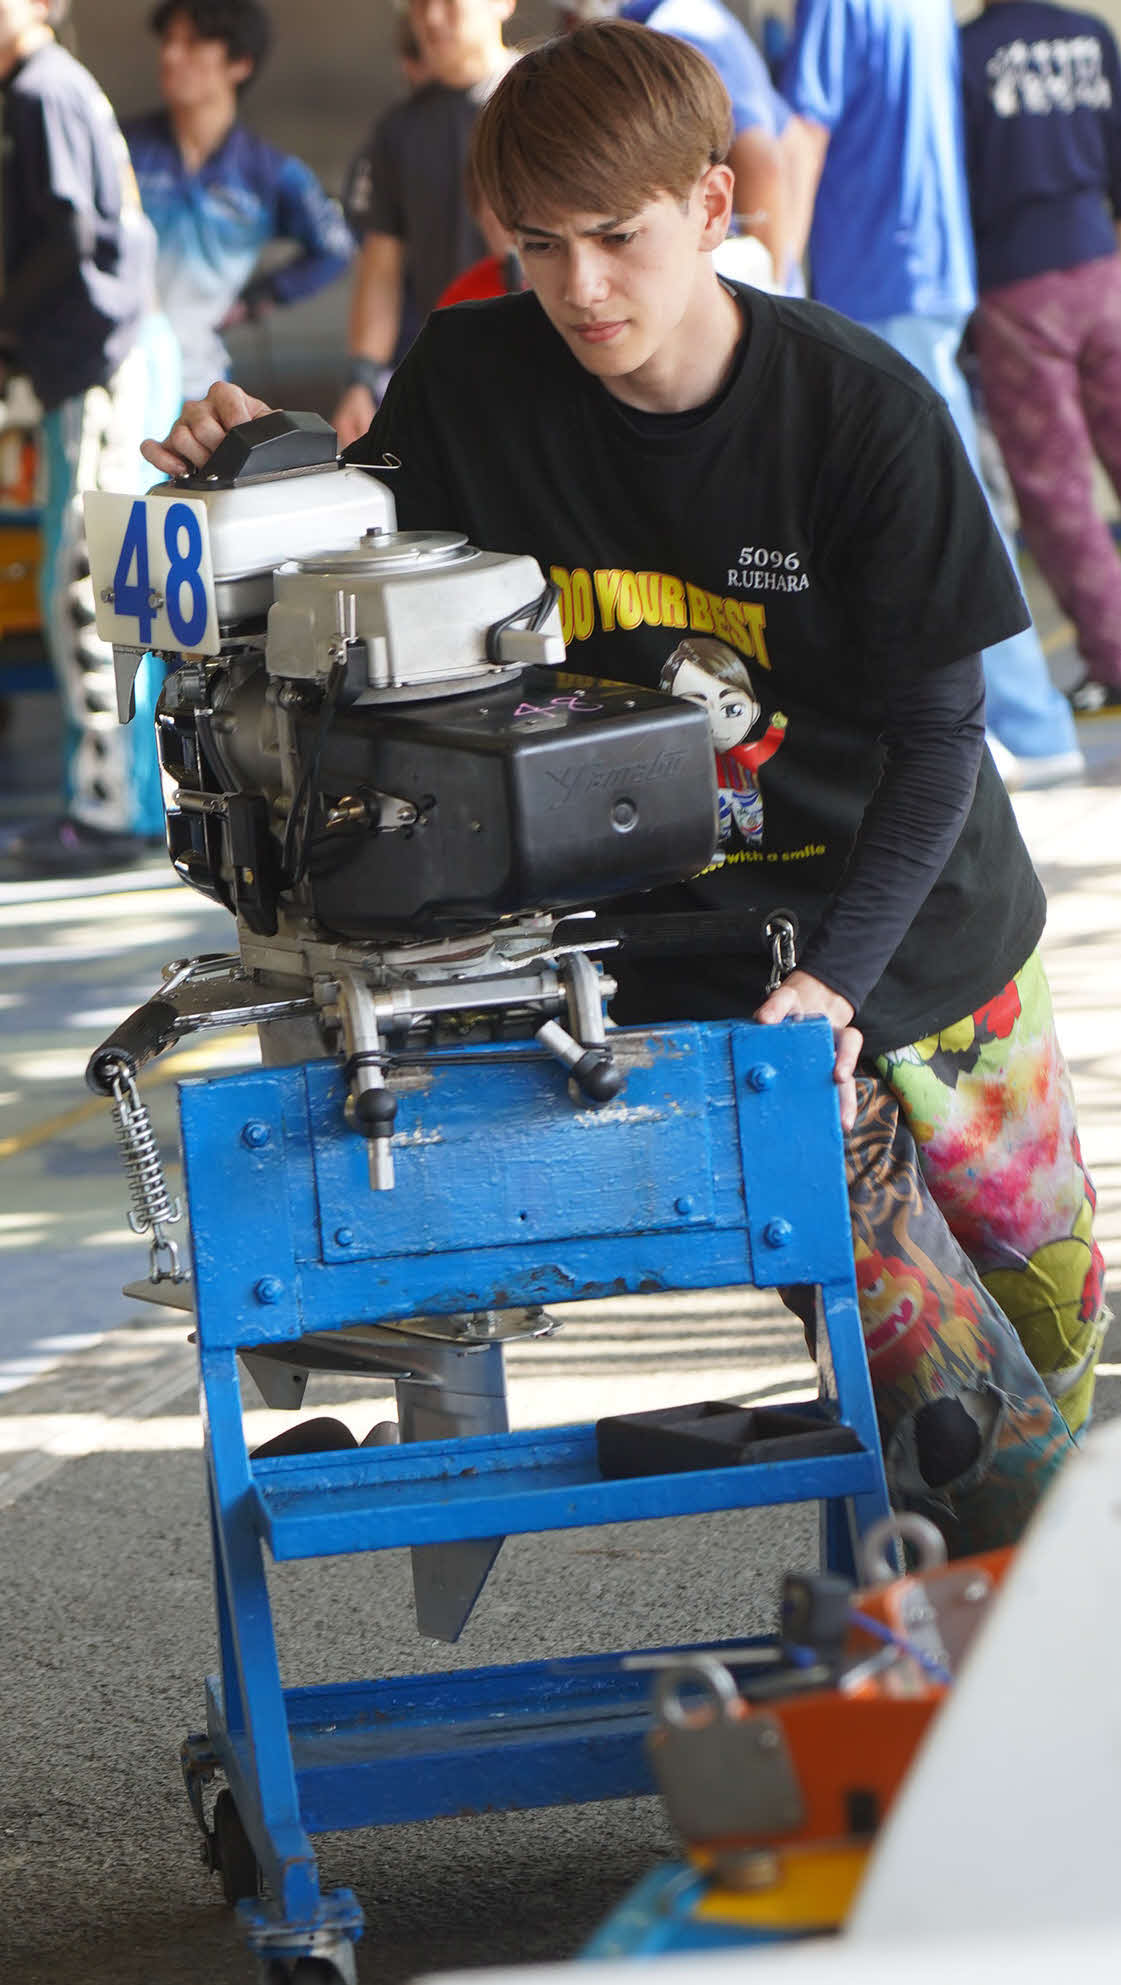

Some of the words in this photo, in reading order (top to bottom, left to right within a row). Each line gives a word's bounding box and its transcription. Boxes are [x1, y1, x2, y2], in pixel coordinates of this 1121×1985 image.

[738, 546, 801, 571] 5096
[113, 500, 208, 647] 48
[727, 569, 810, 593] R.UEHARA
[594, 569, 687, 632] YOUR
[686, 582, 772, 671] BEST
[726, 850, 763, 864] with
[767, 853, 778, 861] a
[782, 844, 826, 861] smile
